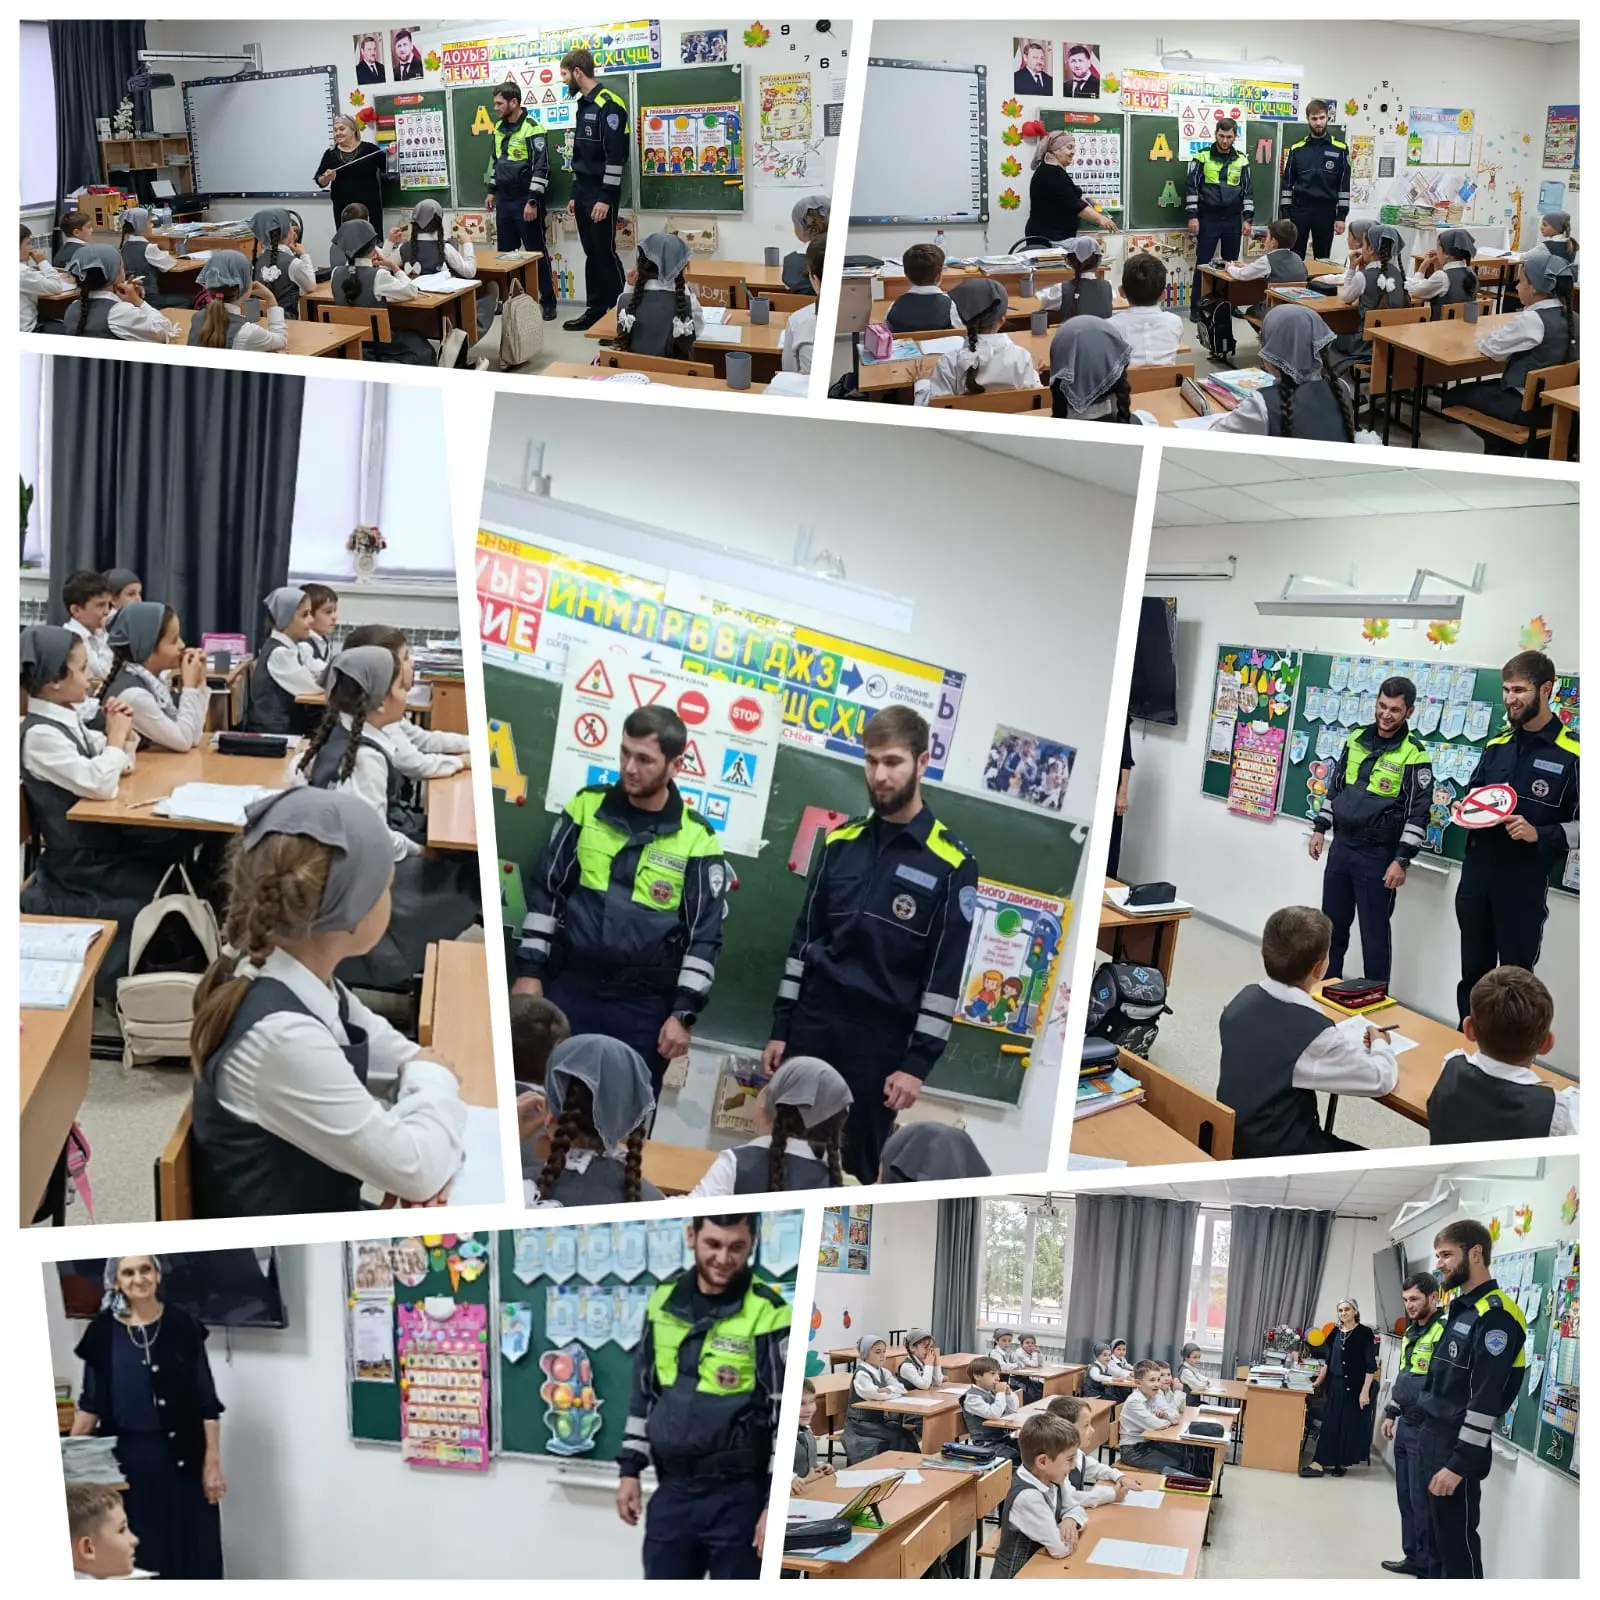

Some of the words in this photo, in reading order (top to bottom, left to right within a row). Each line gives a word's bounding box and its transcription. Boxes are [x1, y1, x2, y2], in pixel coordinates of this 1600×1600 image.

[781, 24, 790, 35] 9
[790, 43, 796, 51] 8
[841, 49, 848, 57] 5
[820, 57, 830, 69] 6
[1149, 133, 1173, 161] Д
[732, 705, 760, 724] STOP
[1007, 892, 1059, 912] ДВИЖЕНИЯ
